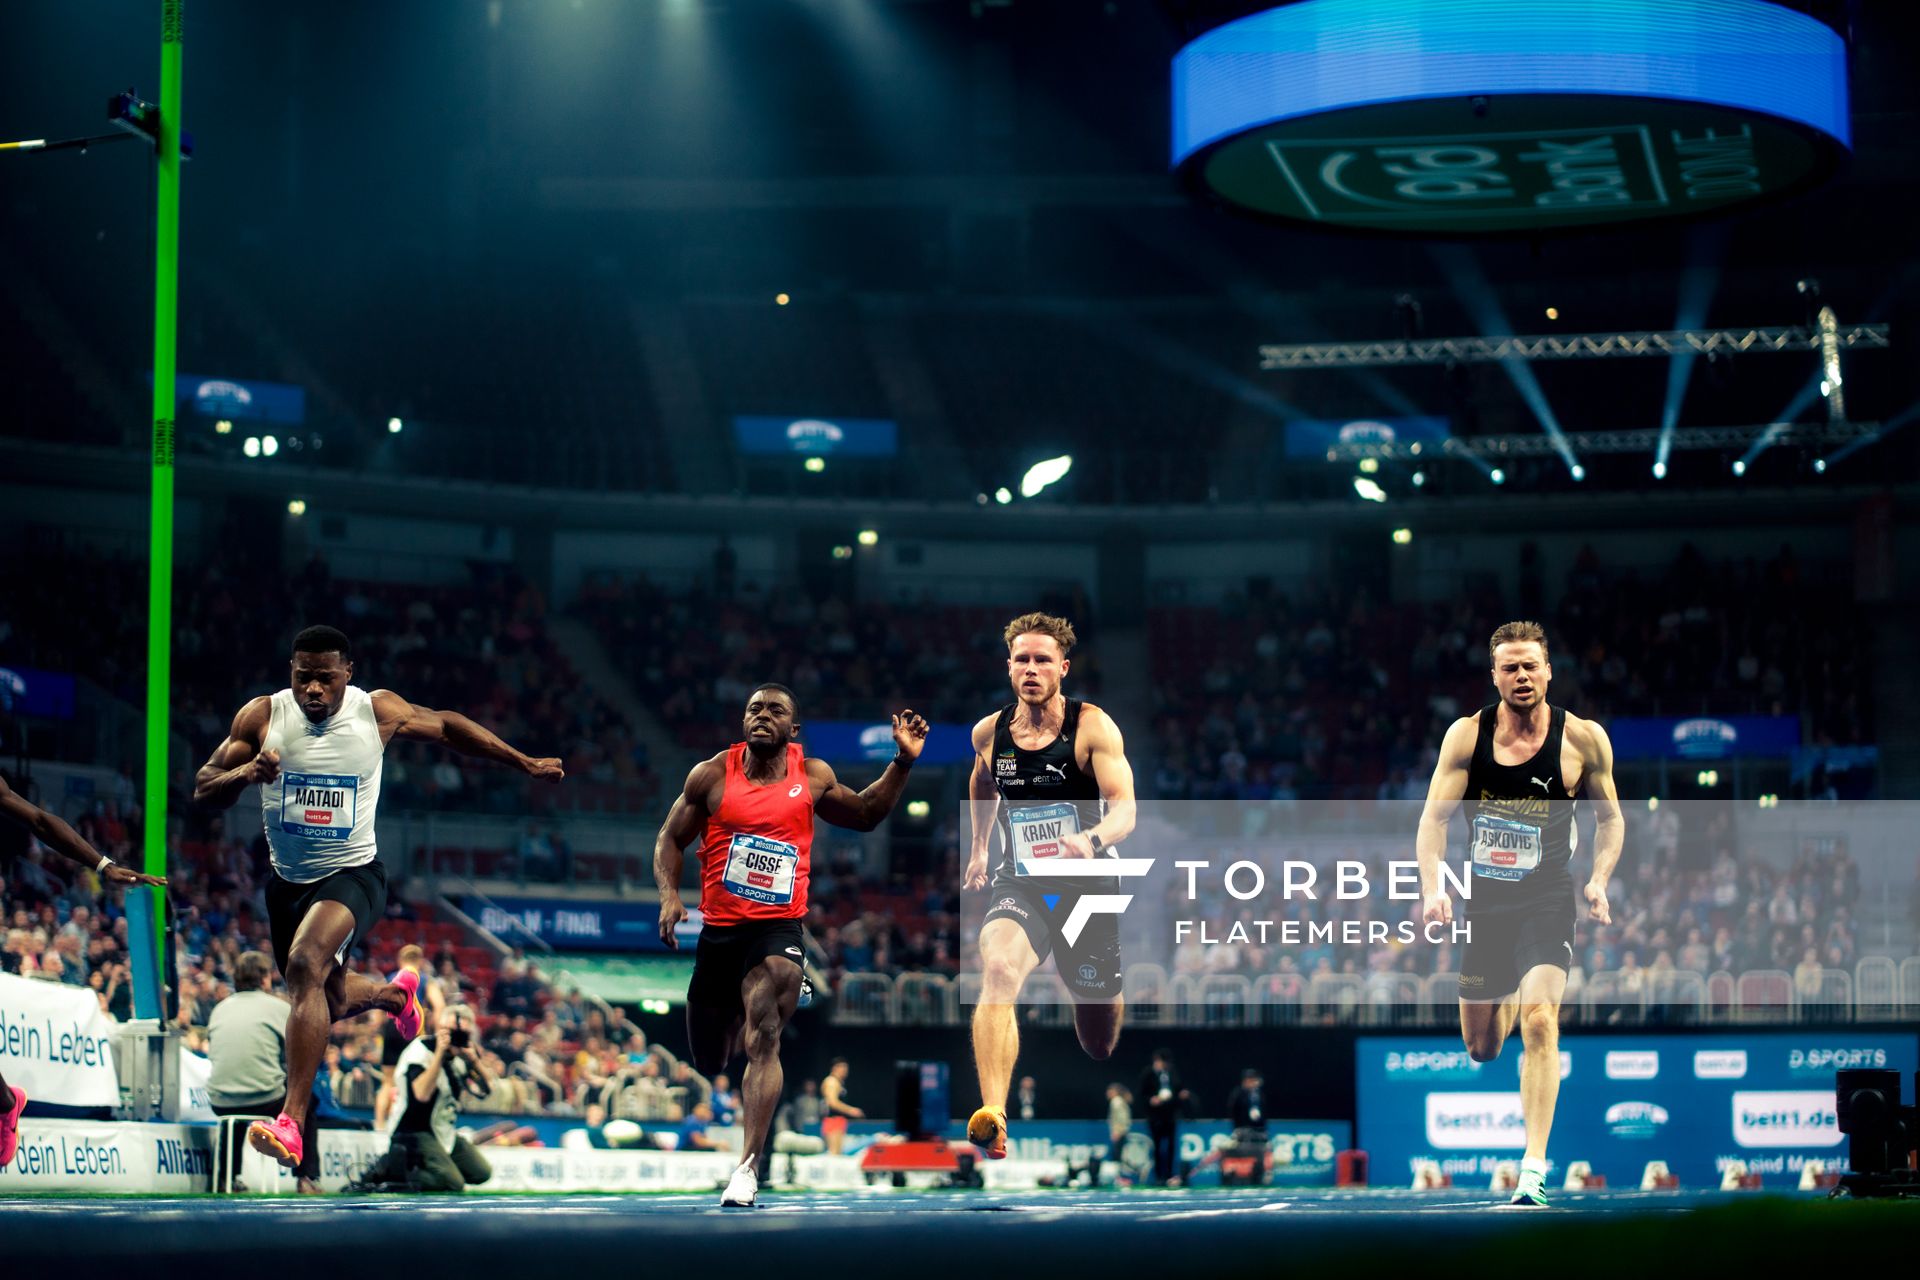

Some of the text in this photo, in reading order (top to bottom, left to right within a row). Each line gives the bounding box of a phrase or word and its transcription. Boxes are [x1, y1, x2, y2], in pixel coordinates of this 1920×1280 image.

[1671, 124, 1759, 199] DOME
[996, 763, 1017, 771] TEAM
[295, 788, 344, 808] MATADI
[1021, 820, 1064, 844] KRANZ
[1481, 831, 1531, 849] ASKOVIC
[746, 852, 782, 874] CISSÉ
[737, 888, 776, 901] D.SPORTS
[1788, 1048, 1883, 1069] D.SPORTS
[16, 1135, 126, 1175] dein Leben.
